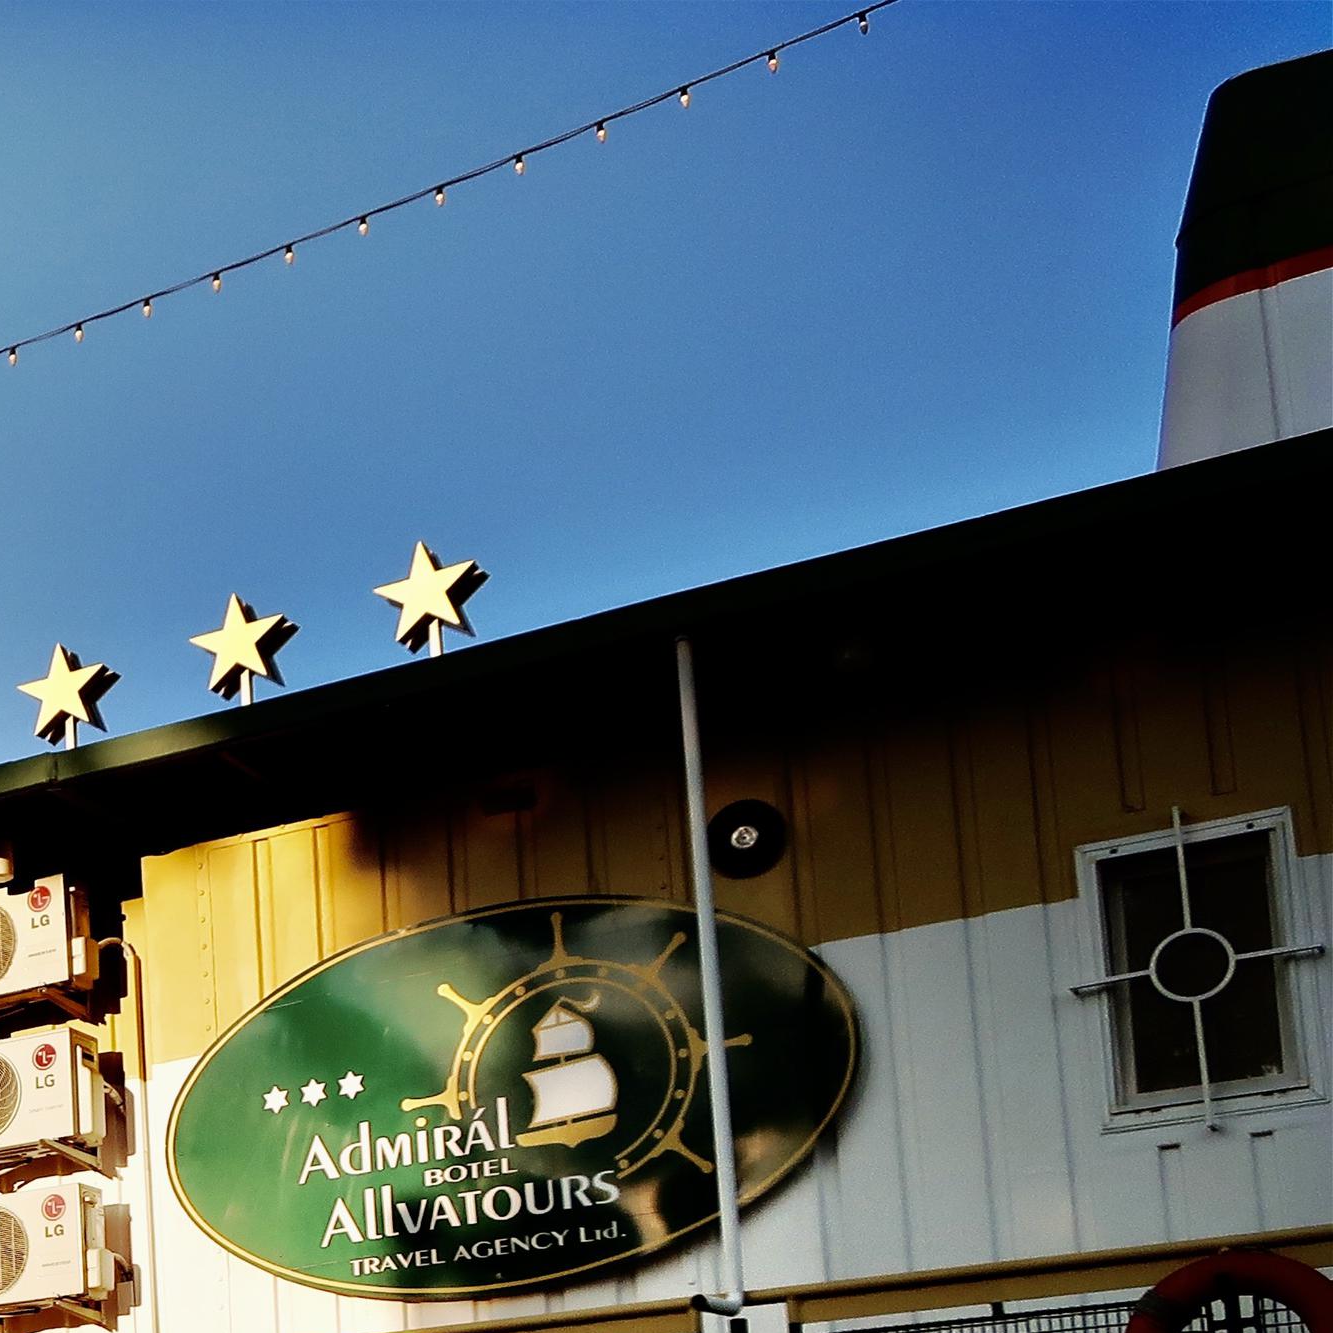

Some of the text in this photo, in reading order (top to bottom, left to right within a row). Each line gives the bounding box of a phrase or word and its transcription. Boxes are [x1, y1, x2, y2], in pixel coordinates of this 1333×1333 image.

[30, 914, 51, 929] LG
[35, 1073, 56, 1090] LG
[423, 1157, 518, 1188] BOTEL
[44, 1223, 65, 1239] LG
[349, 1248, 447, 1277] TRAVEL
[452, 1228, 570, 1262] AGENCY
